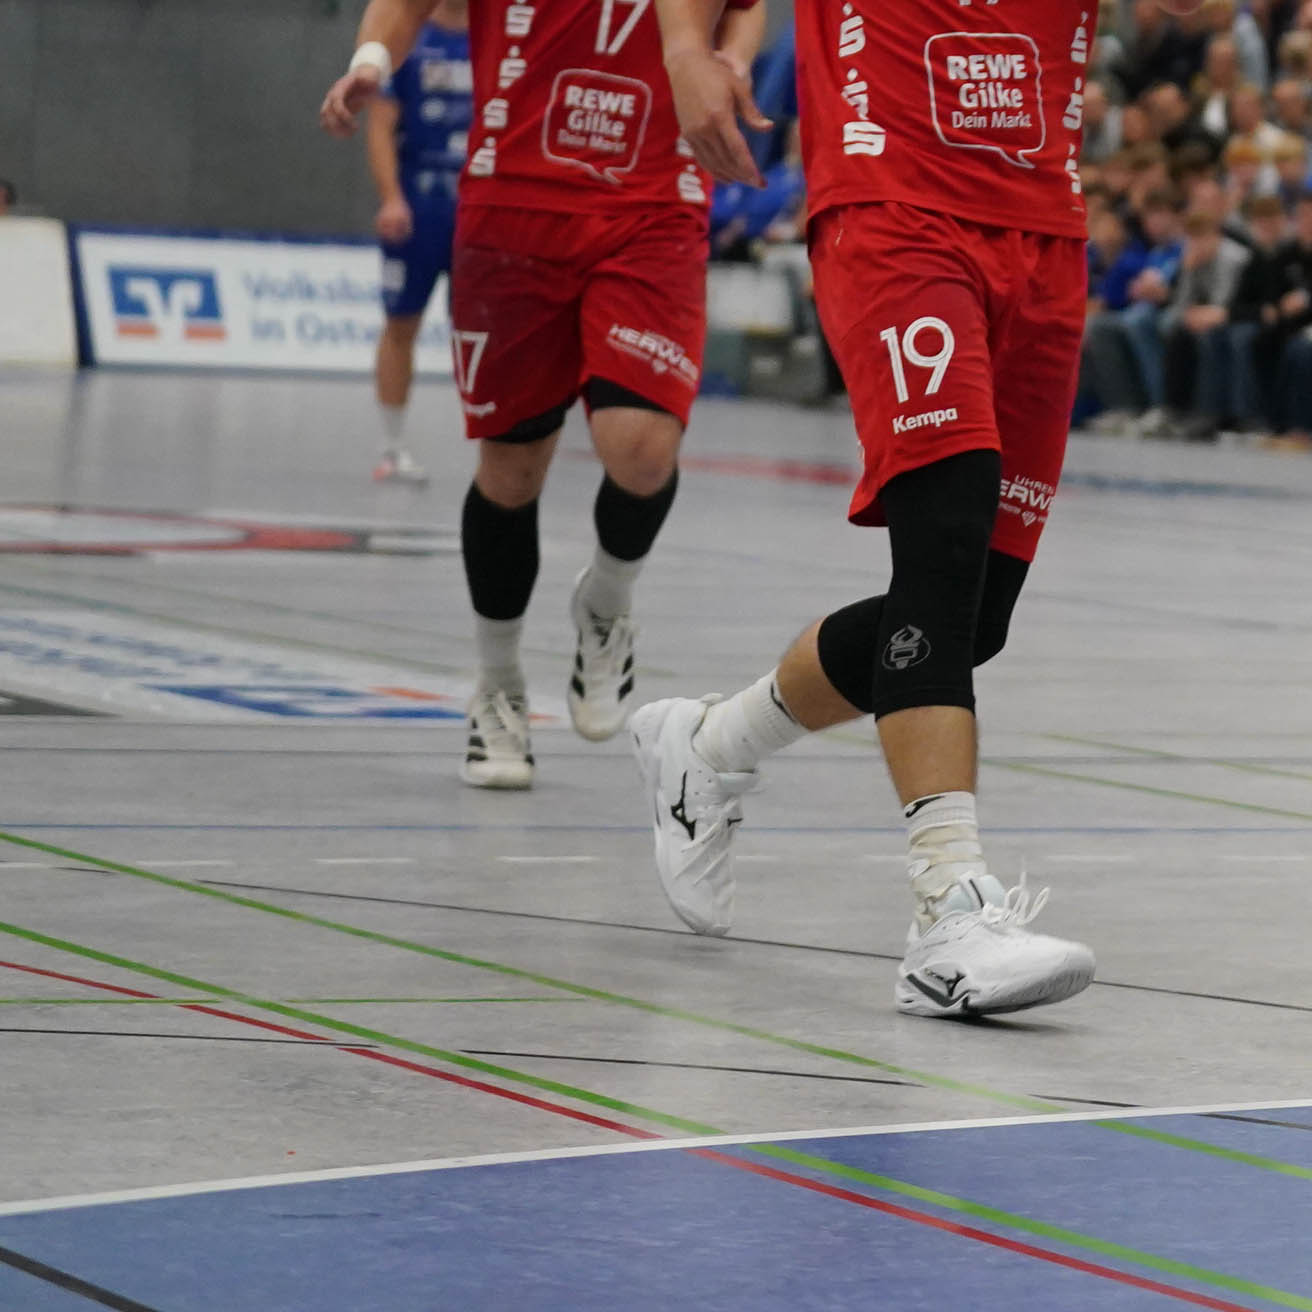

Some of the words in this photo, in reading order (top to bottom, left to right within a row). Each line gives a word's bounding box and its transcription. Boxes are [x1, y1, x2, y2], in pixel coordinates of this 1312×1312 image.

[946, 54, 1028, 80] REWE
[565, 85, 635, 118] REWE
[959, 81, 1024, 108] Gilke
[952, 112, 987, 129] Dein
[990, 111, 1033, 129] Markt
[879, 316, 956, 404] 19
[892, 406, 958, 436] Kempa
